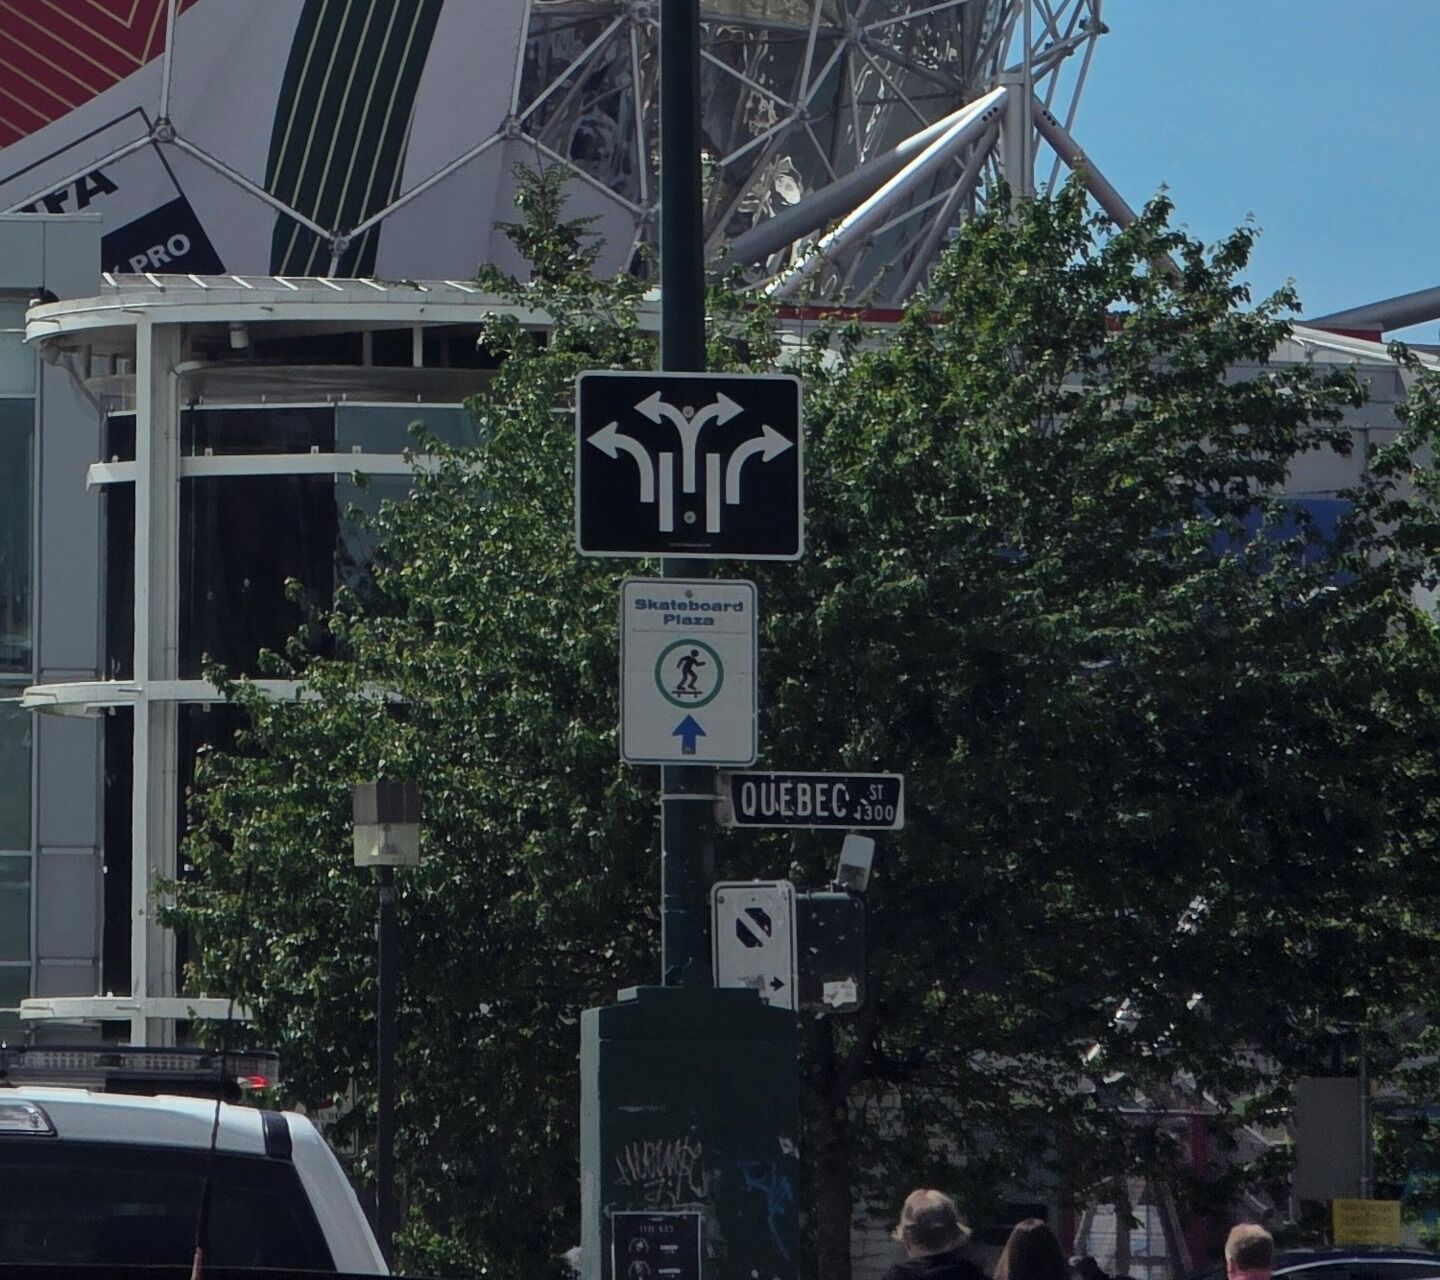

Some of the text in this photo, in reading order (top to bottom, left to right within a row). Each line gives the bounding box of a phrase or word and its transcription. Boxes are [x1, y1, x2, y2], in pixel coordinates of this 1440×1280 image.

[129, 233, 191, 274] PRO
[635, 598, 744, 612] Skateboard
[663, 613, 715, 626] Plaza
[741, 781, 884, 817] QUEBEC ST
[854, 804, 894, 821] 1300
